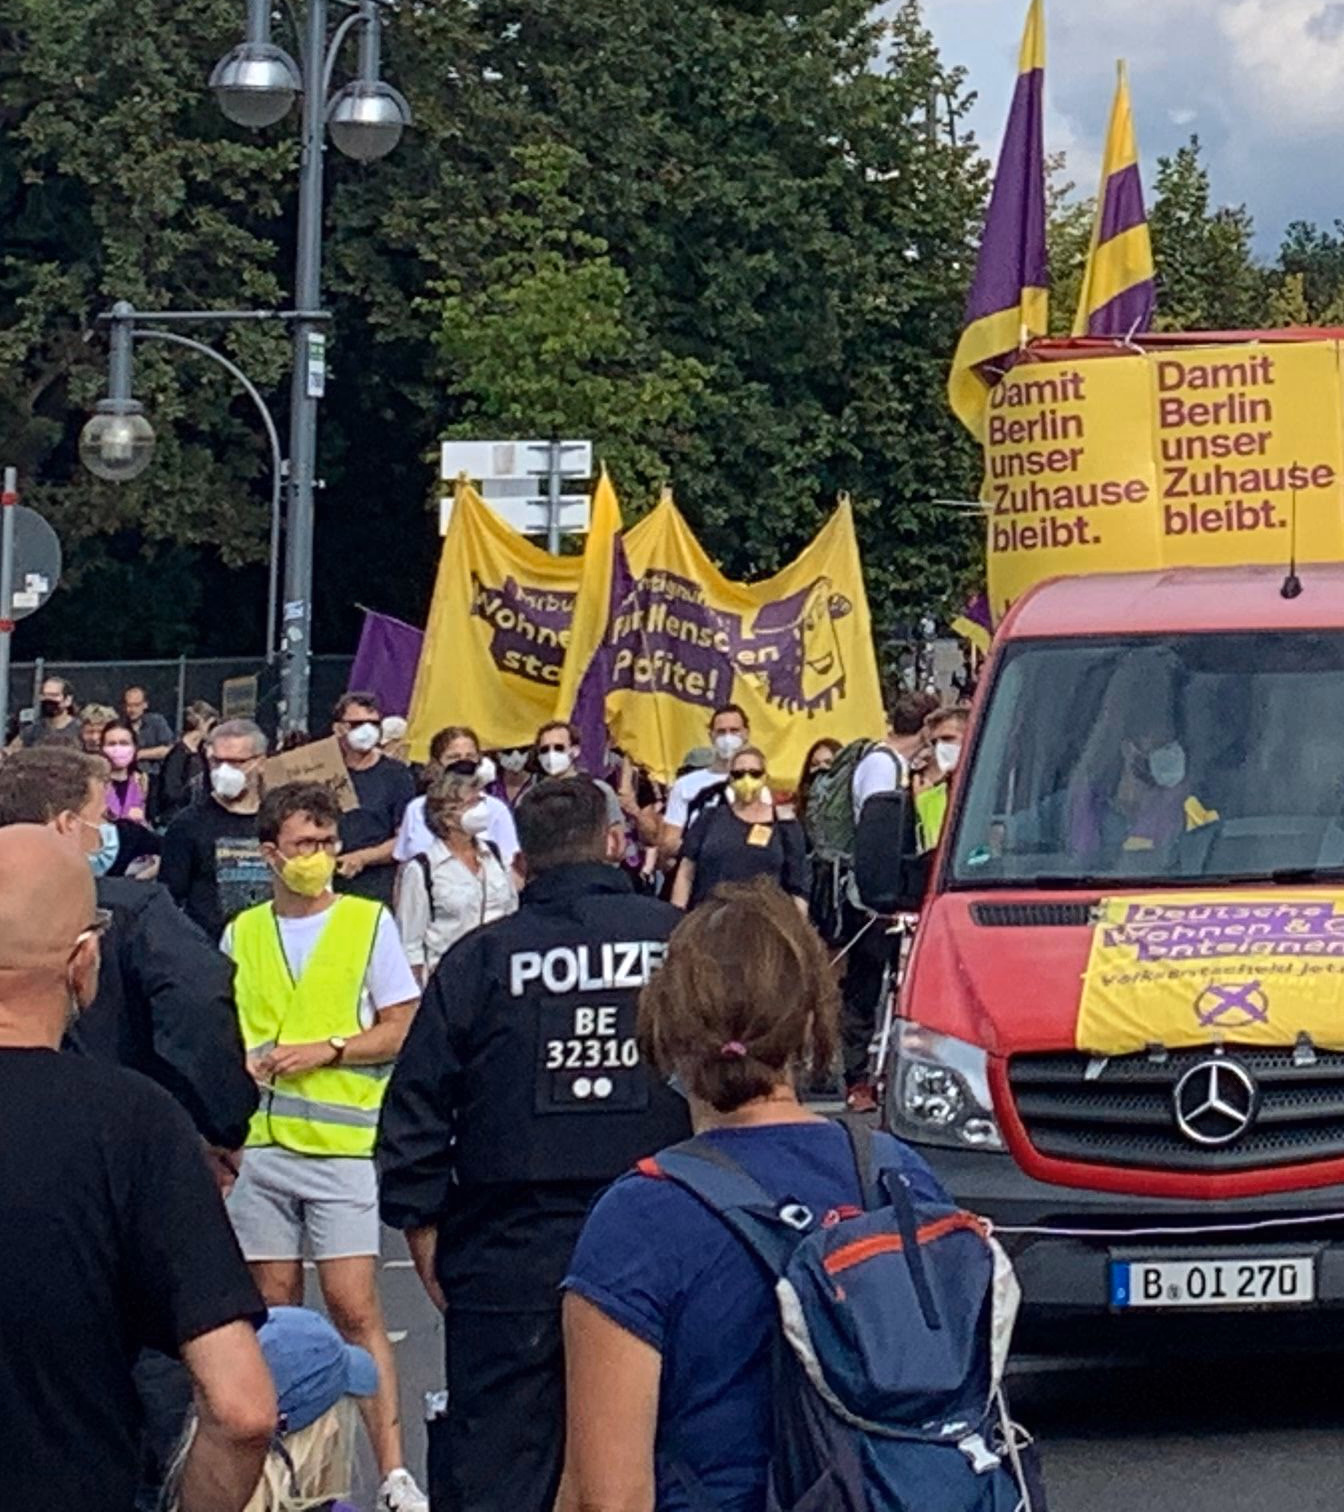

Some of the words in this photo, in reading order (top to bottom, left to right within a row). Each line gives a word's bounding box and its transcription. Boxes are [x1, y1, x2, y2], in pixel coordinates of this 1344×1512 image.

[990, 370, 1085, 409] Damit
[1157, 356, 1274, 391] Damit
[989, 410, 1083, 446] Berlin
[1159, 393, 1272, 429] Berlin
[990, 446, 1083, 479] unser
[1161, 430, 1272, 462] unser
[993, 479, 1149, 516] Zuhause
[1163, 463, 1335, 498] Zuhause
[993, 515, 1101, 553] bleibt.
[1164, 499, 1287, 536] bleibt.
[475, 588, 571, 648] Wohne
[648, 603, 779, 665] Menscen
[613, 649, 719, 700] Pofite!
[1134, 904, 1321, 921] Deutsche
[1111, 922, 1271, 945] Wohnen
[1284, 918, 1311, 934] &
[510, 941, 668, 997] POLIZE
[575, 1007, 617, 1036] BE
[546, 1039, 639, 1069] 32310
[1143, 1269, 1163, 1299] B
[1237, 1264, 1298, 1298] 270
